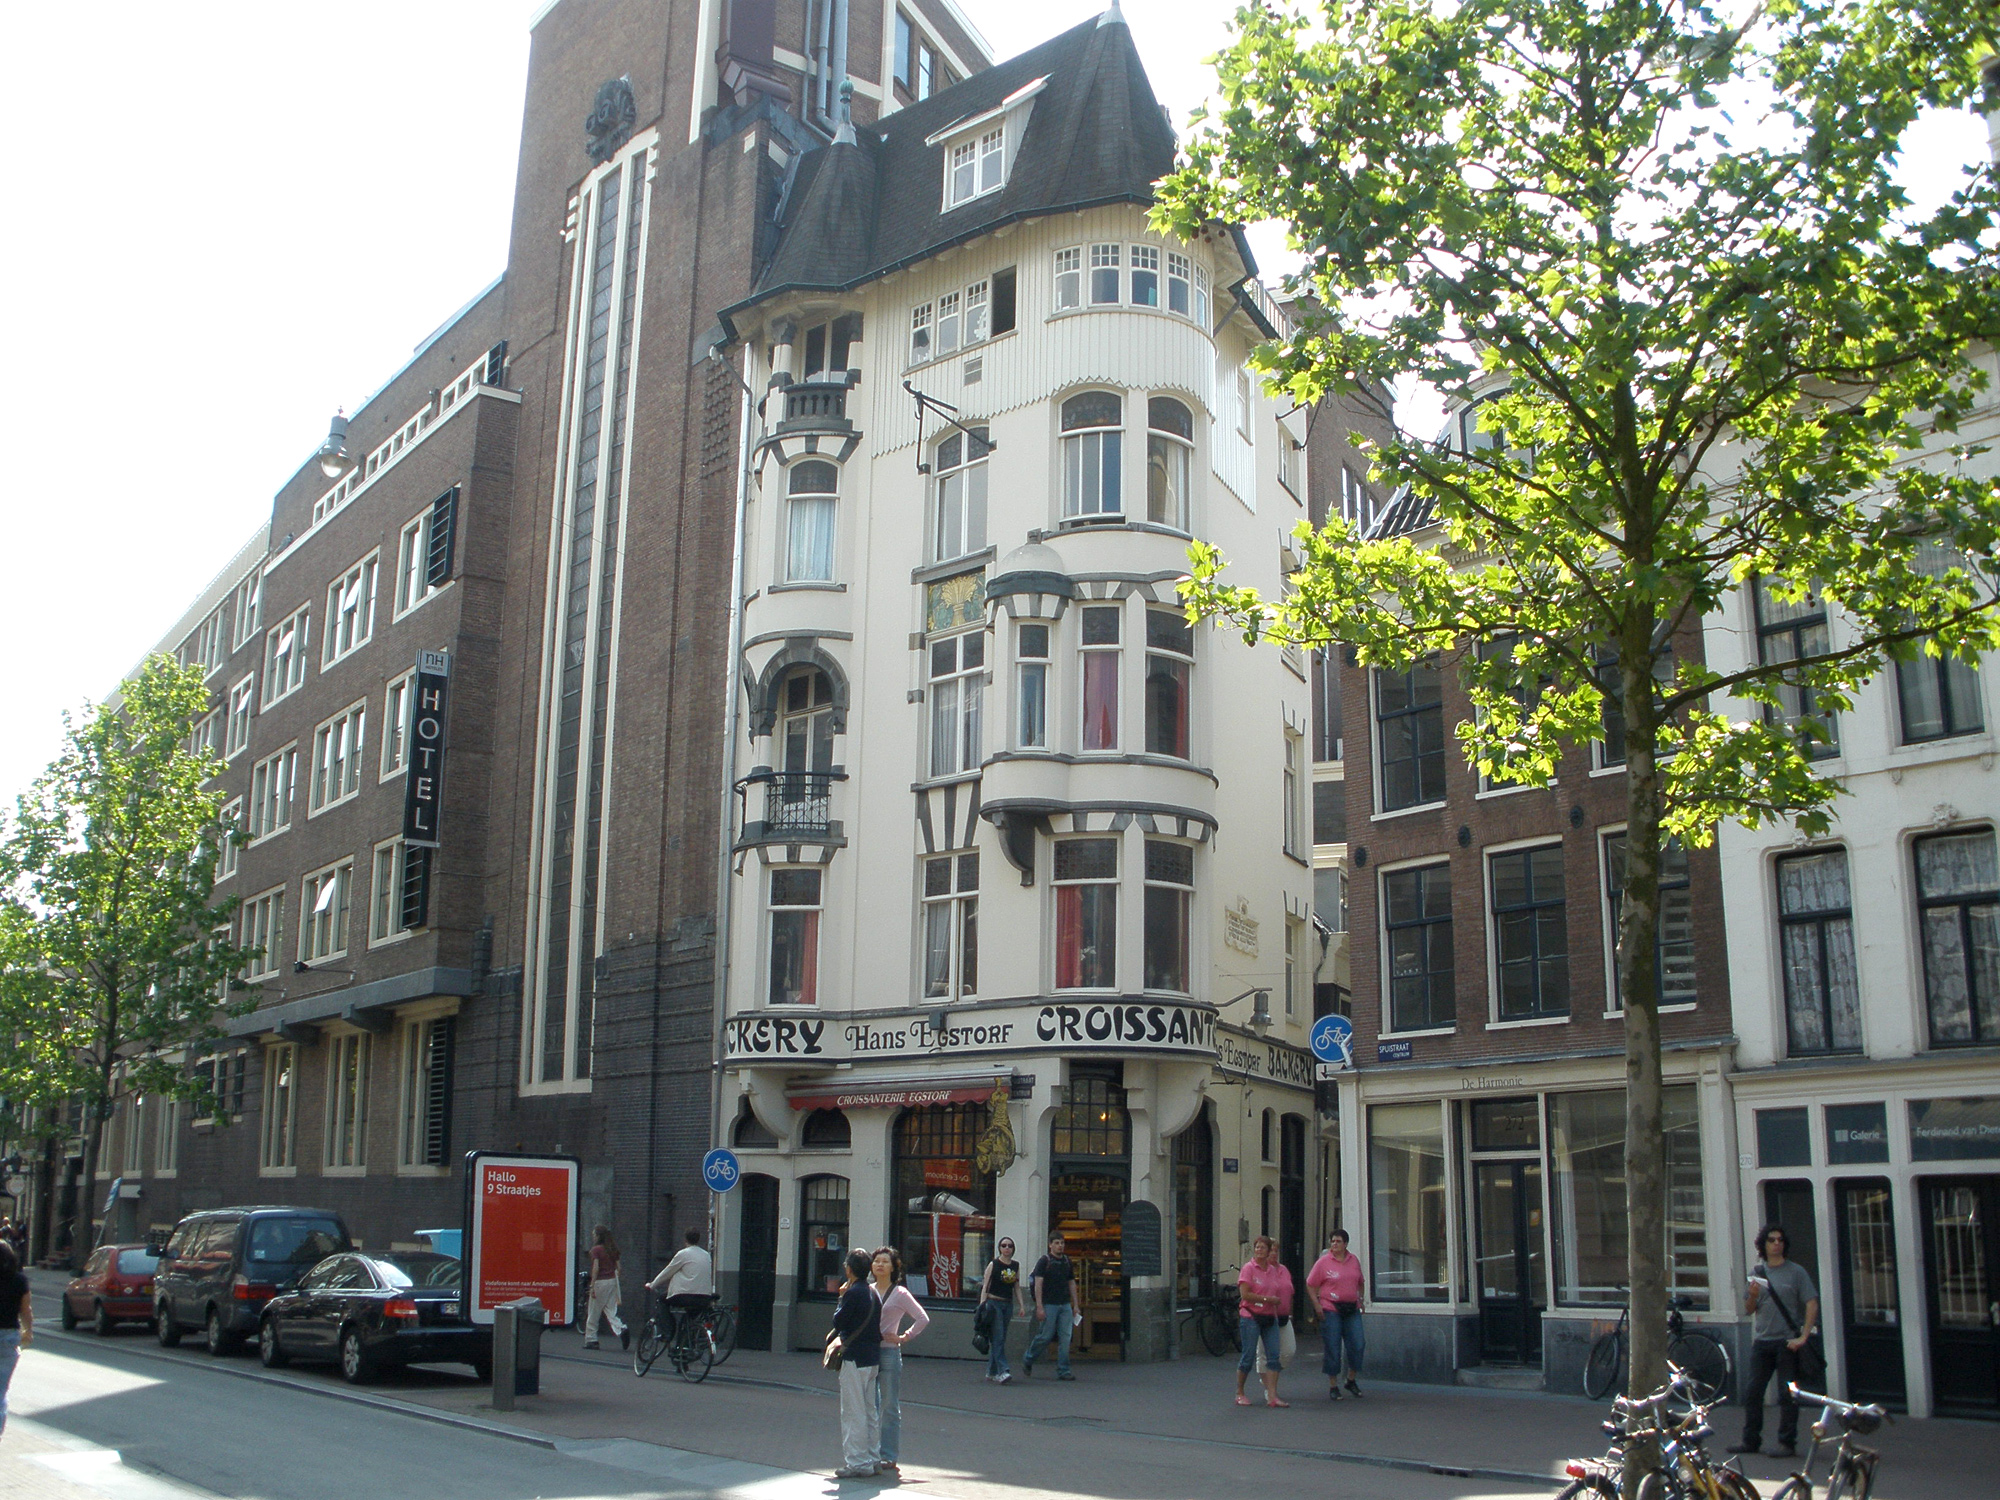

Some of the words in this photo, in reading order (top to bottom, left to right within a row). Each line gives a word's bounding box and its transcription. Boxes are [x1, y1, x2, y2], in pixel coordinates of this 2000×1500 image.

[415, 687, 440, 830] HOTEL
[725, 1018, 825, 1055] CKERY
[844, 1024, 906, 1051] Hans
[1378, 1043, 1410, 1054] SPUISTRAAT
[1267, 1045, 1313, 1087] BACKERY
[1462, 1077, 1475, 1091] De
[1477, 1075, 1523, 1089] Harmonie
[836, 1093, 906, 1106] CROISSANTERIE
[909, 1090, 952, 1102] EGSTORF
[1505, 1115, 1525, 1131] 272
[1850, 1130, 1880, 1141] Galerie
[1916, 1126, 1960, 1137] Ferdinand
[1961, 1126, 1977, 1135] van
[487, 1170, 517, 1182] Hallo
[487, 1183, 494, 1194] 9
[496, 1183, 542, 1197] Straatjes
